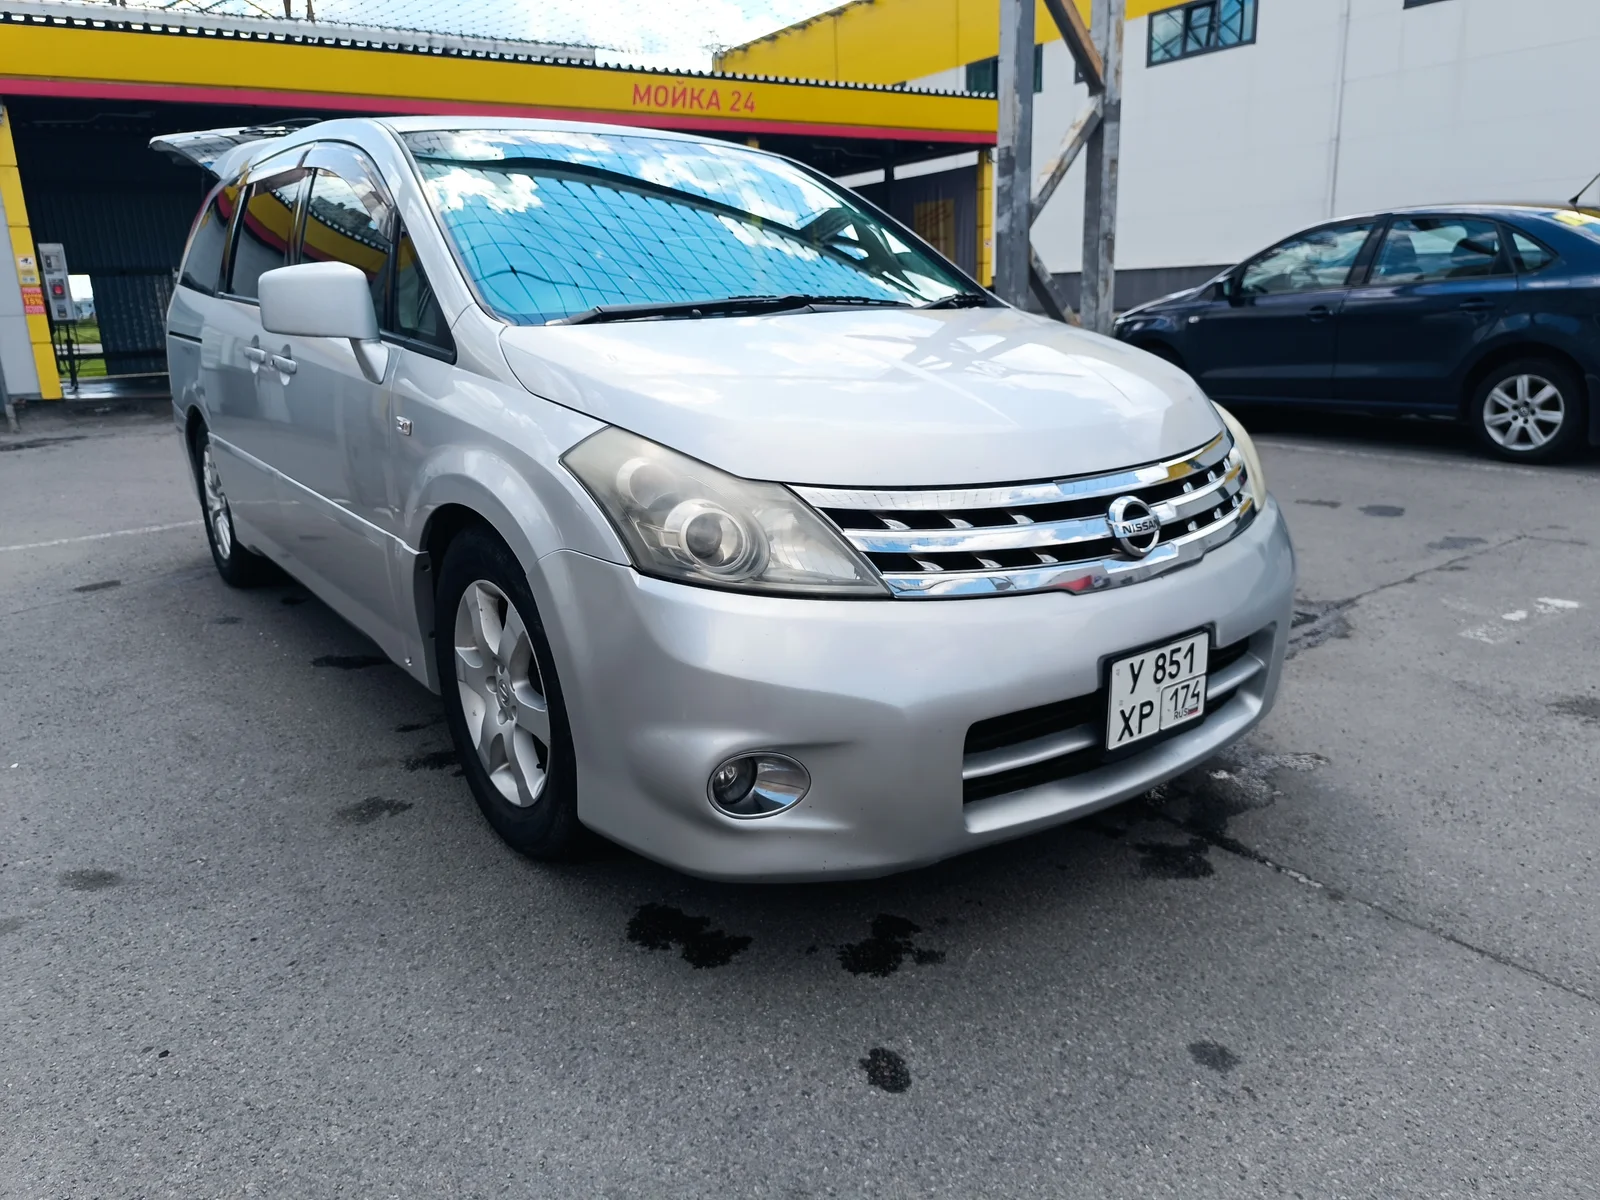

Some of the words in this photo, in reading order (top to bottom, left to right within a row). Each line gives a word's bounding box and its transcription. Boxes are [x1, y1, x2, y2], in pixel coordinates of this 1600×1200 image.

[633, 80, 721, 111] МОЙКА
[730, 91, 756, 113] 24
[1122, 516, 1160, 535] NISSAN
[1153, 642, 1195, 684] 851
[1169, 680, 1200, 711] 174
[1173, 707, 1188, 720] RUS
